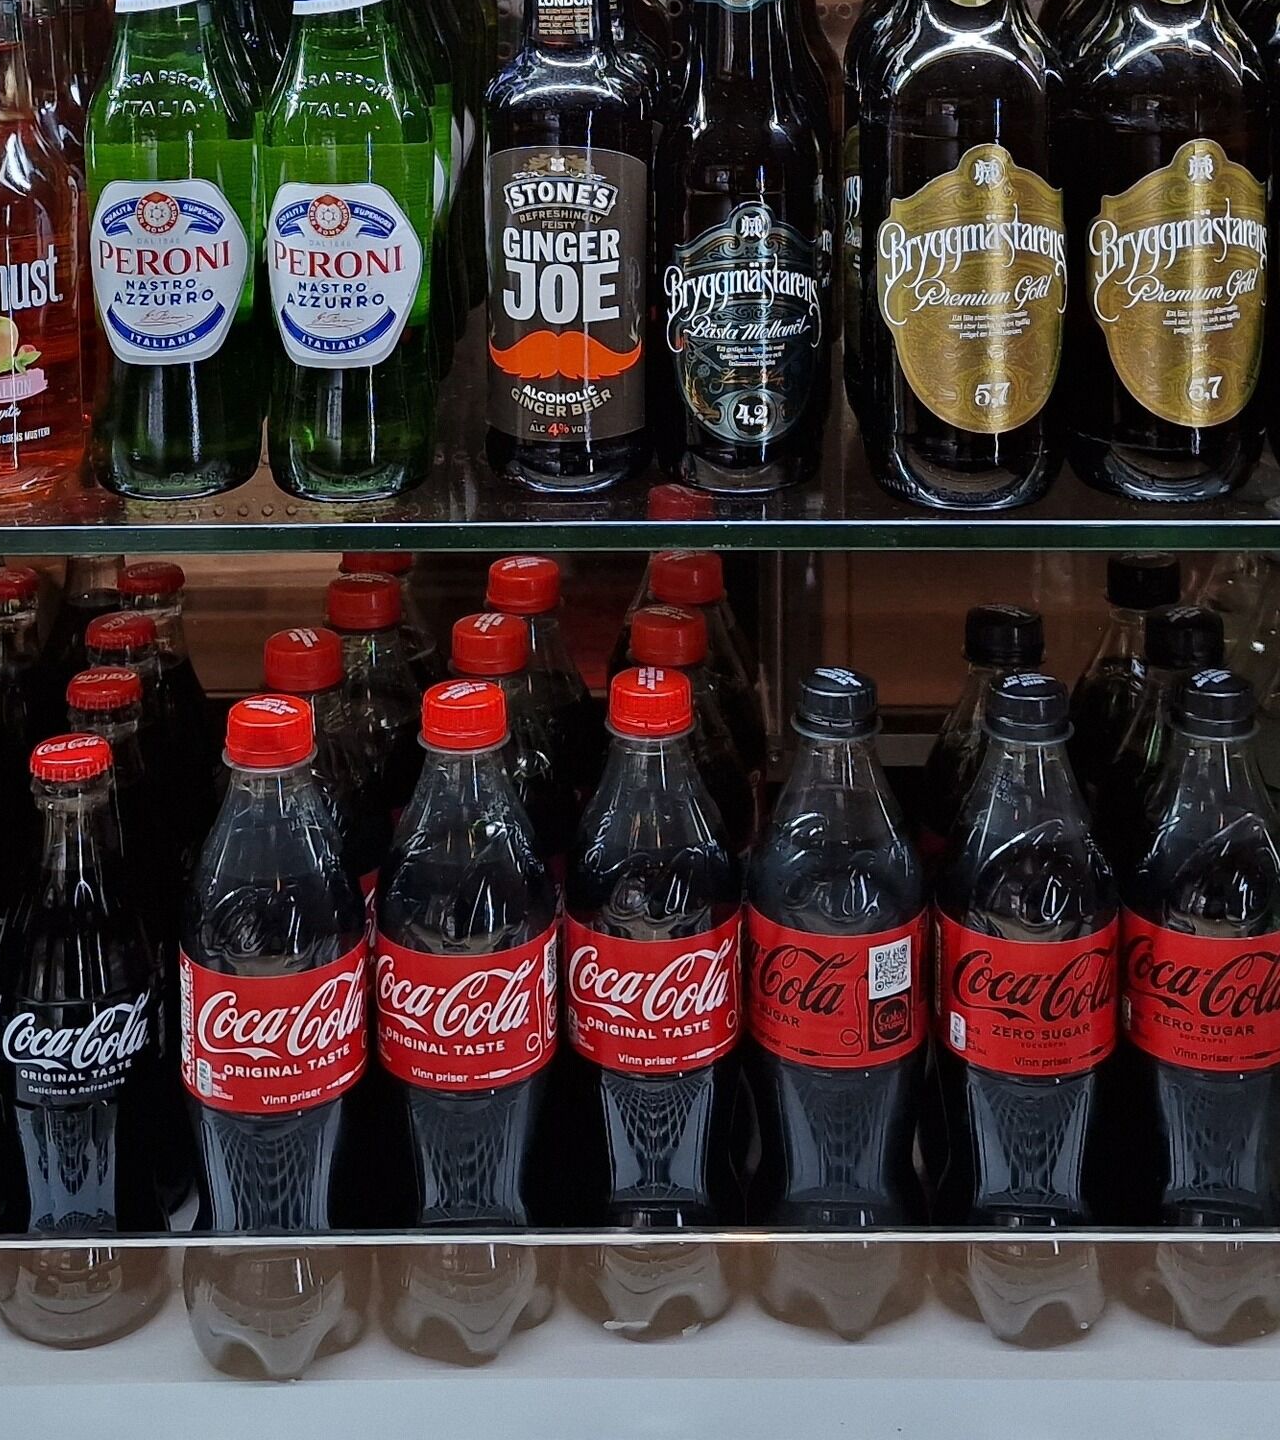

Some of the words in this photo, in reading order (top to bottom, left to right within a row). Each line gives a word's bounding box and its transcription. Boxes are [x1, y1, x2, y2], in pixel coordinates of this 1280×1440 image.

[510, 181, 610, 208] STONE'S
[520, 209, 603, 224] REFRESHINGLY
[541, 221, 576, 230] FEISTY
[503, 227, 620, 263] GINGER
[880, 203, 1067, 310] Bryggmästarens
[1088, 198, 1267, 306] Bryggmästarens
[99, 239, 231, 276] PERONI
[274, 240, 404, 279] PERONI
[126, 278, 196, 291] NASTRO
[298, 281, 367, 293] NASTRO
[503, 260, 620, 324] JOE
[664, 253, 821, 340] Bryggmästarens
[911, 278, 1010, 311] Premium
[1014, 274, 1052, 309] Gold
[1124, 275, 1221, 309] Premium
[1227, 268, 1256, 302] Gold
[114, 289, 214, 306] AZZURRO
[286, 292, 385, 309] AZZURRO
[130, 331, 196, 348] ITALIANA
[684, 315, 736, 340] Bästa
[740, 315, 811, 340] Mellanöl
[302, 334, 367, 350] ITALIANA
[511, 388, 567, 417] GINGER
[571, 389, 613, 416] BEER
[523, 384, 597, 404] ALCOHOLIC
[547, 422, 570, 436] 4%
[36, 736, 104, 756] Coca-Cola
[569, 936, 735, 1023] Coca-Cola
[197, 957, 364, 1059] Coca-Cola
[376, 954, 538, 1038] Coca-Cola
[2, 989, 151, 1071] Coca-Cola
[586, 1018, 657, 1040] ORIGINAL
[663, 1020, 710, 1038] TASTE
[991, 1023, 1035, 1041] ZERO
[1042, 1023, 1090, 1040] SUGAR
[1153, 1012, 1195, 1033] ZERO
[1200, 1023, 1255, 1036] SUGAR
[386, 1027, 448, 1056] ORIGINAL
[453, 1040, 505, 1056] TASTE
[224, 1062, 302, 1079] ORIGINAL
[308, 1044, 351, 1071] TASTE
[618, 1053, 642, 1066] Vinn
[645, 1053, 677, 1068] priser
[1013, 1055, 1038, 1067] Vinn
[1041, 1055, 1072, 1068] priser
[1173, 1045, 1197, 1061] Vinn
[1200, 1049, 1233, 1063] priser
[20, 1068, 86, 1083] ORIGINAL
[92, 1058, 132, 1078] TASTE
[411, 1066, 434, 1082] Vinn
[436, 1070, 468, 1084] priser
[261, 1092, 288, 1106] Vinn
[290, 1085, 321, 1104] priser
